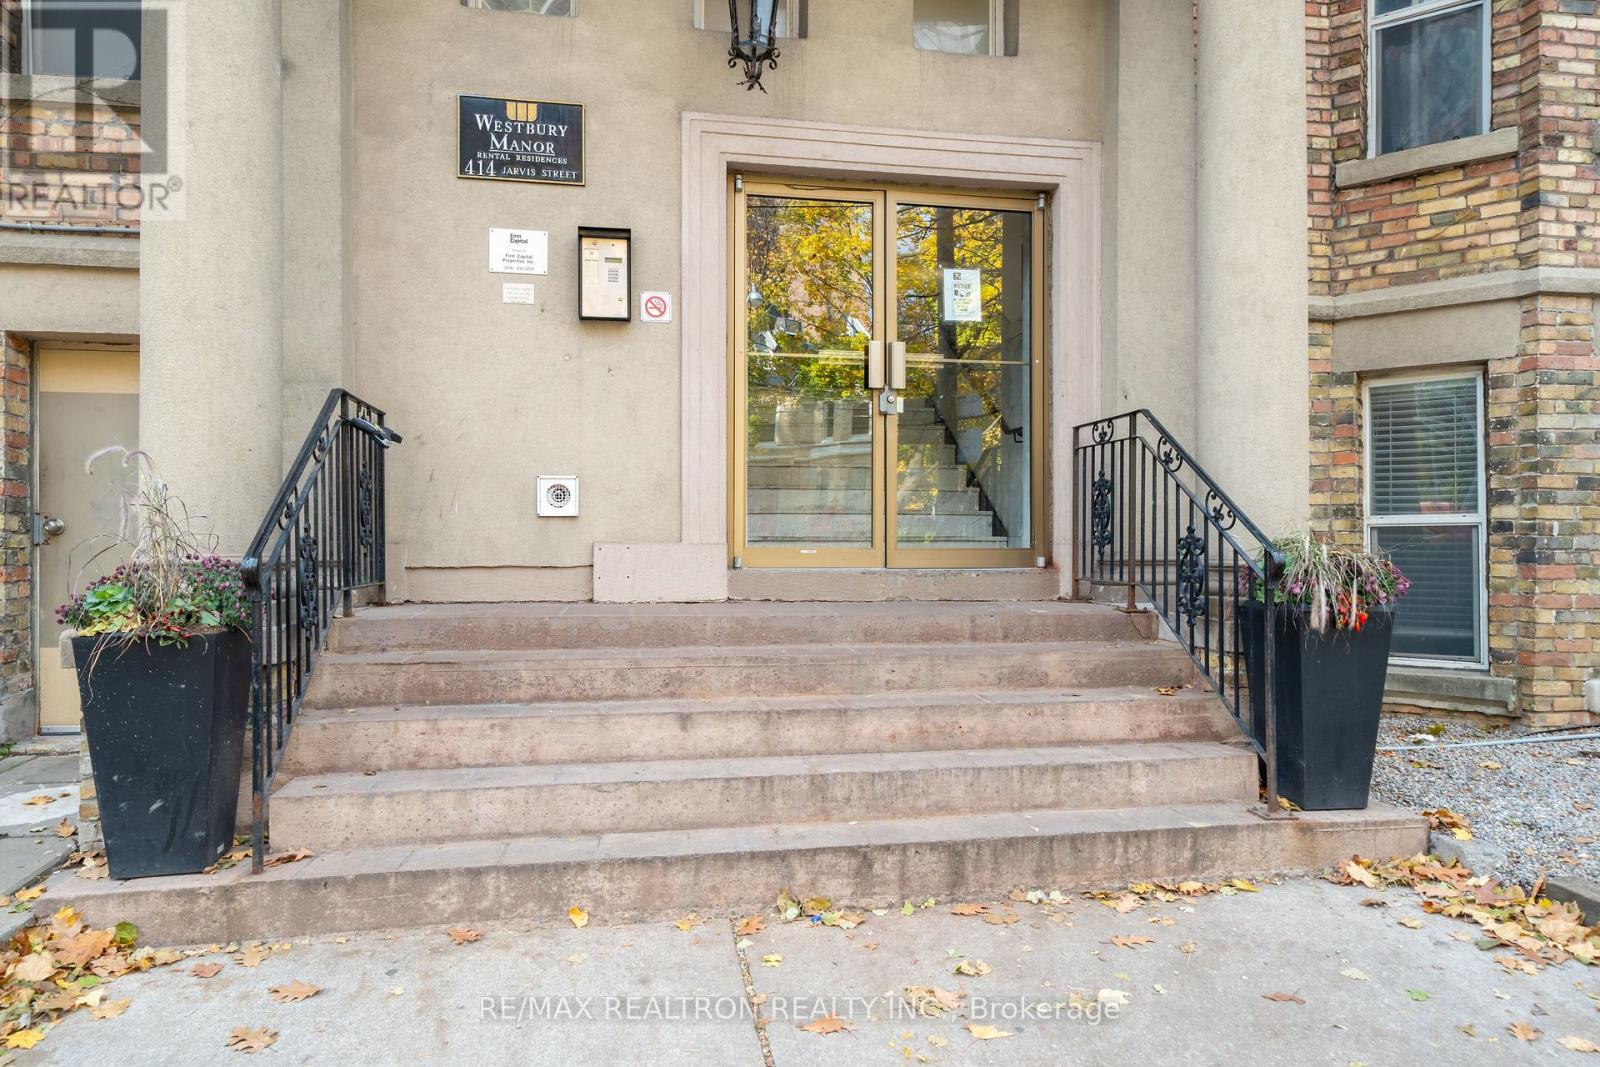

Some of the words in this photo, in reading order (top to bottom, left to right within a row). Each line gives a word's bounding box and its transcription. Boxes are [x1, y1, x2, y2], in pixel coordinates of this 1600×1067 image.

[474, 113, 568, 137] WESTBURY
[489, 132, 555, 154] MANOR
[477, 151, 511, 161] RENTAL
[516, 154, 568, 164] RESIDENCES
[464, 158, 497, 176] 414
[502, 166, 536, 177] JARVIS
[541, 169, 577, 179] STREET
